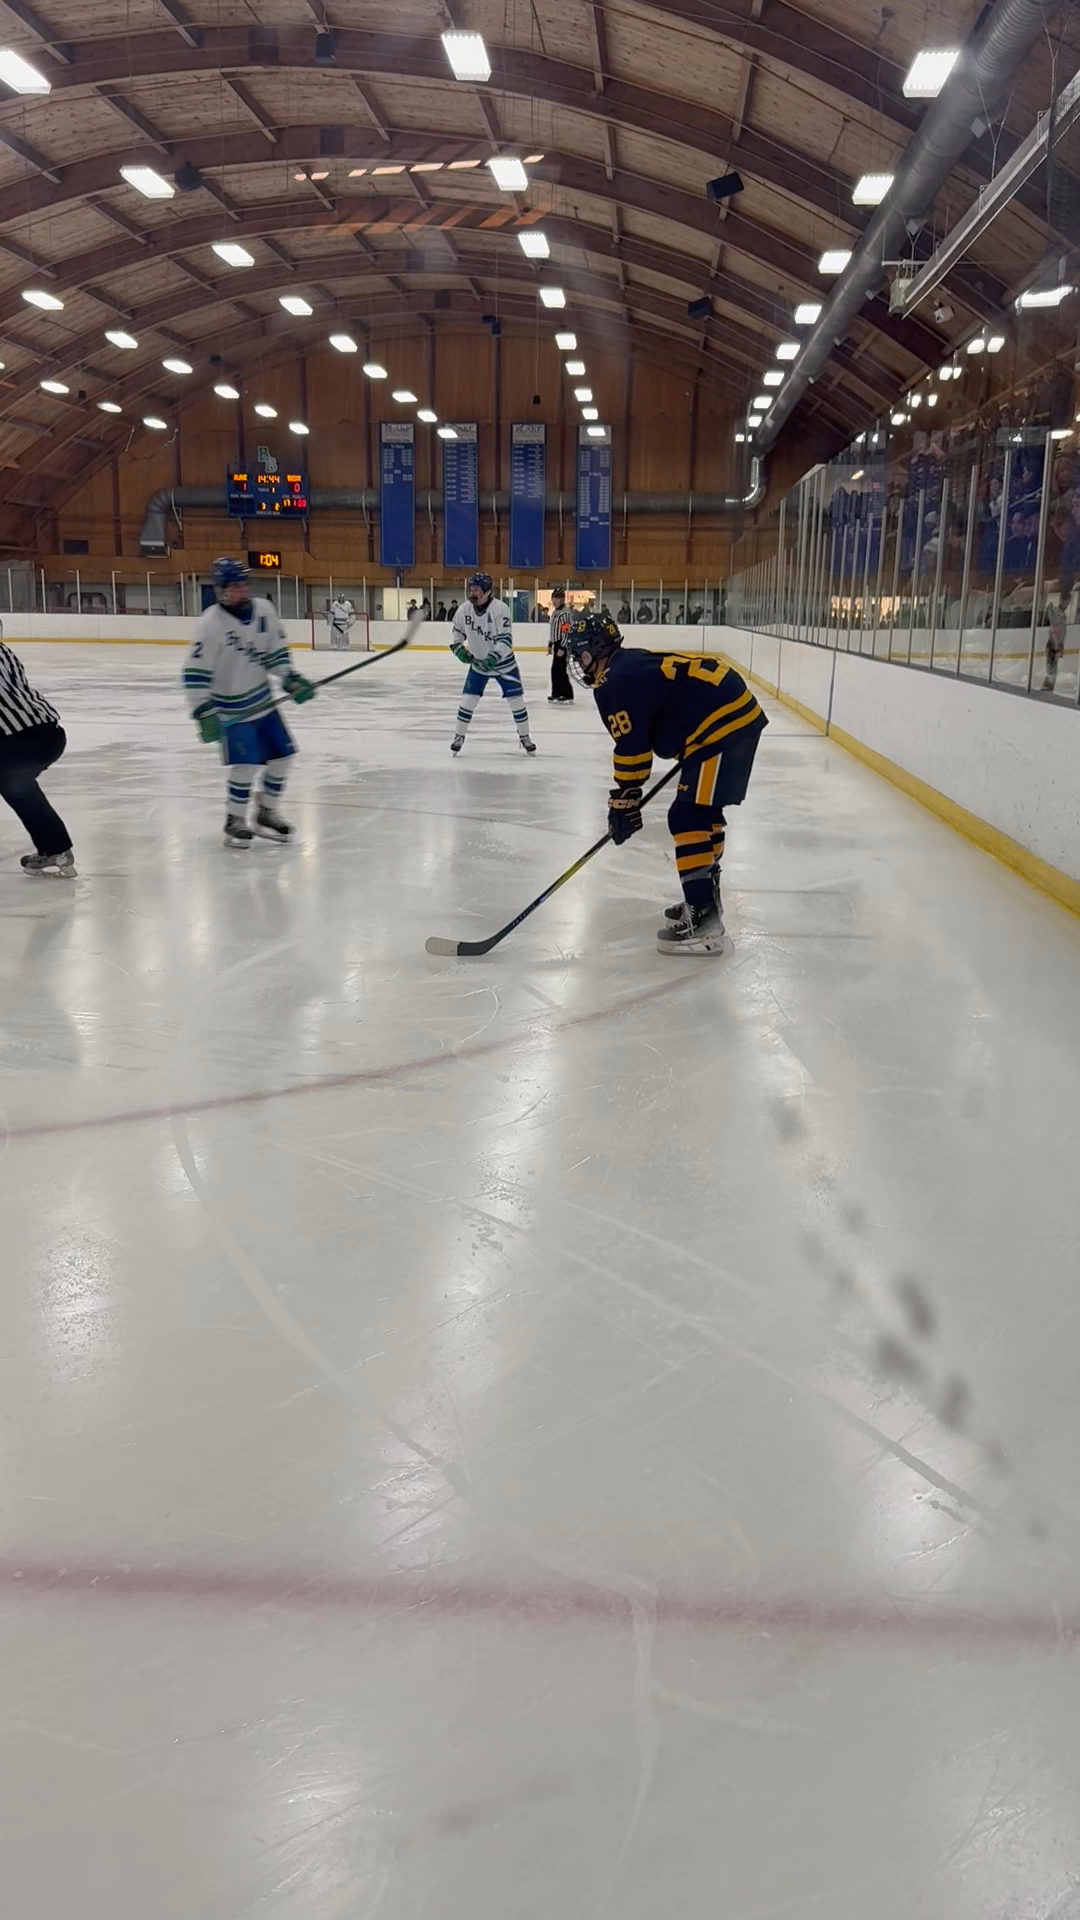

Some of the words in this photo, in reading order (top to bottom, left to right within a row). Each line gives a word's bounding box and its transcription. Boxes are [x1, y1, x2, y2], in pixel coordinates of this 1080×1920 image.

[257, 475, 280, 484] 14:44
[294, 483, 301, 493] 0
[260, 554, 279, 567] 1:04
[607, 710, 632, 738] 28
